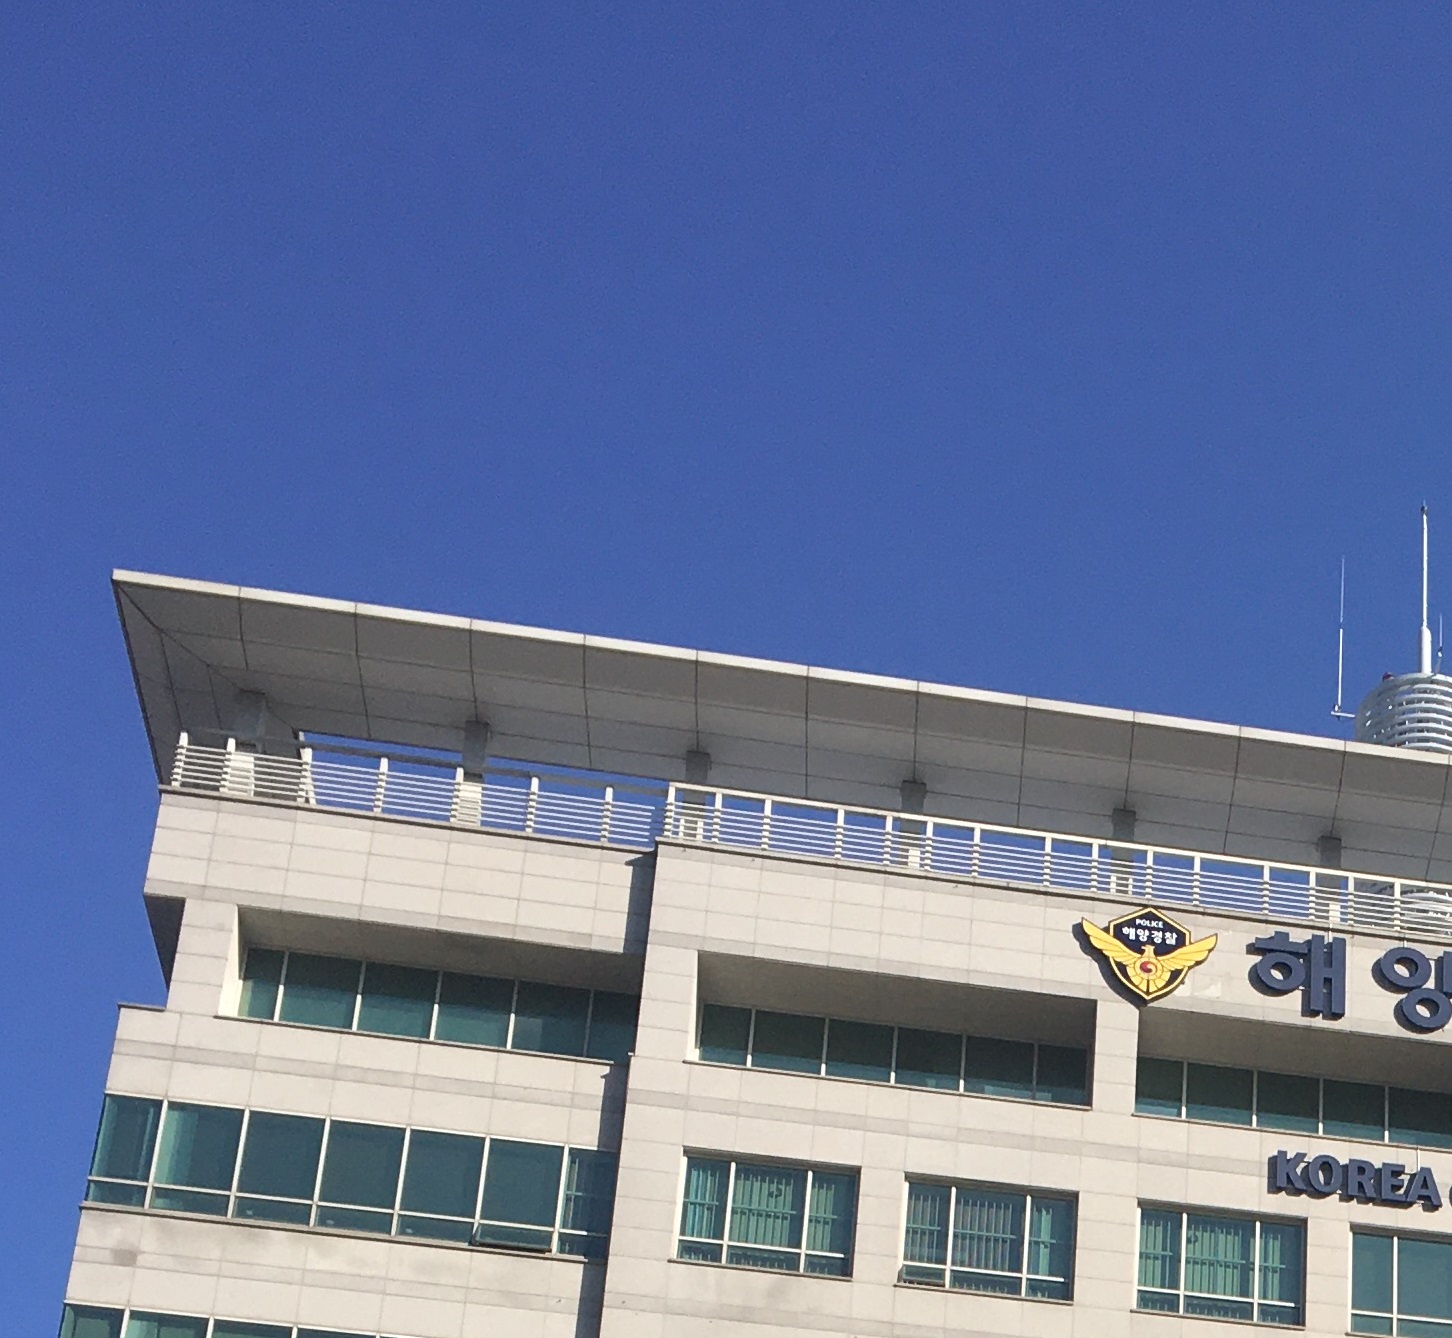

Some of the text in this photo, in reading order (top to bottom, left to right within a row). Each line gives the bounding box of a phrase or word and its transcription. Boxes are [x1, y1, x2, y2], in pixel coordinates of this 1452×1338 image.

[1135, 918, 1164, 928] POLICE
[1121, 926, 1178, 946] 해양경찰
[1273, 1150, 1441, 1207] KOREA
